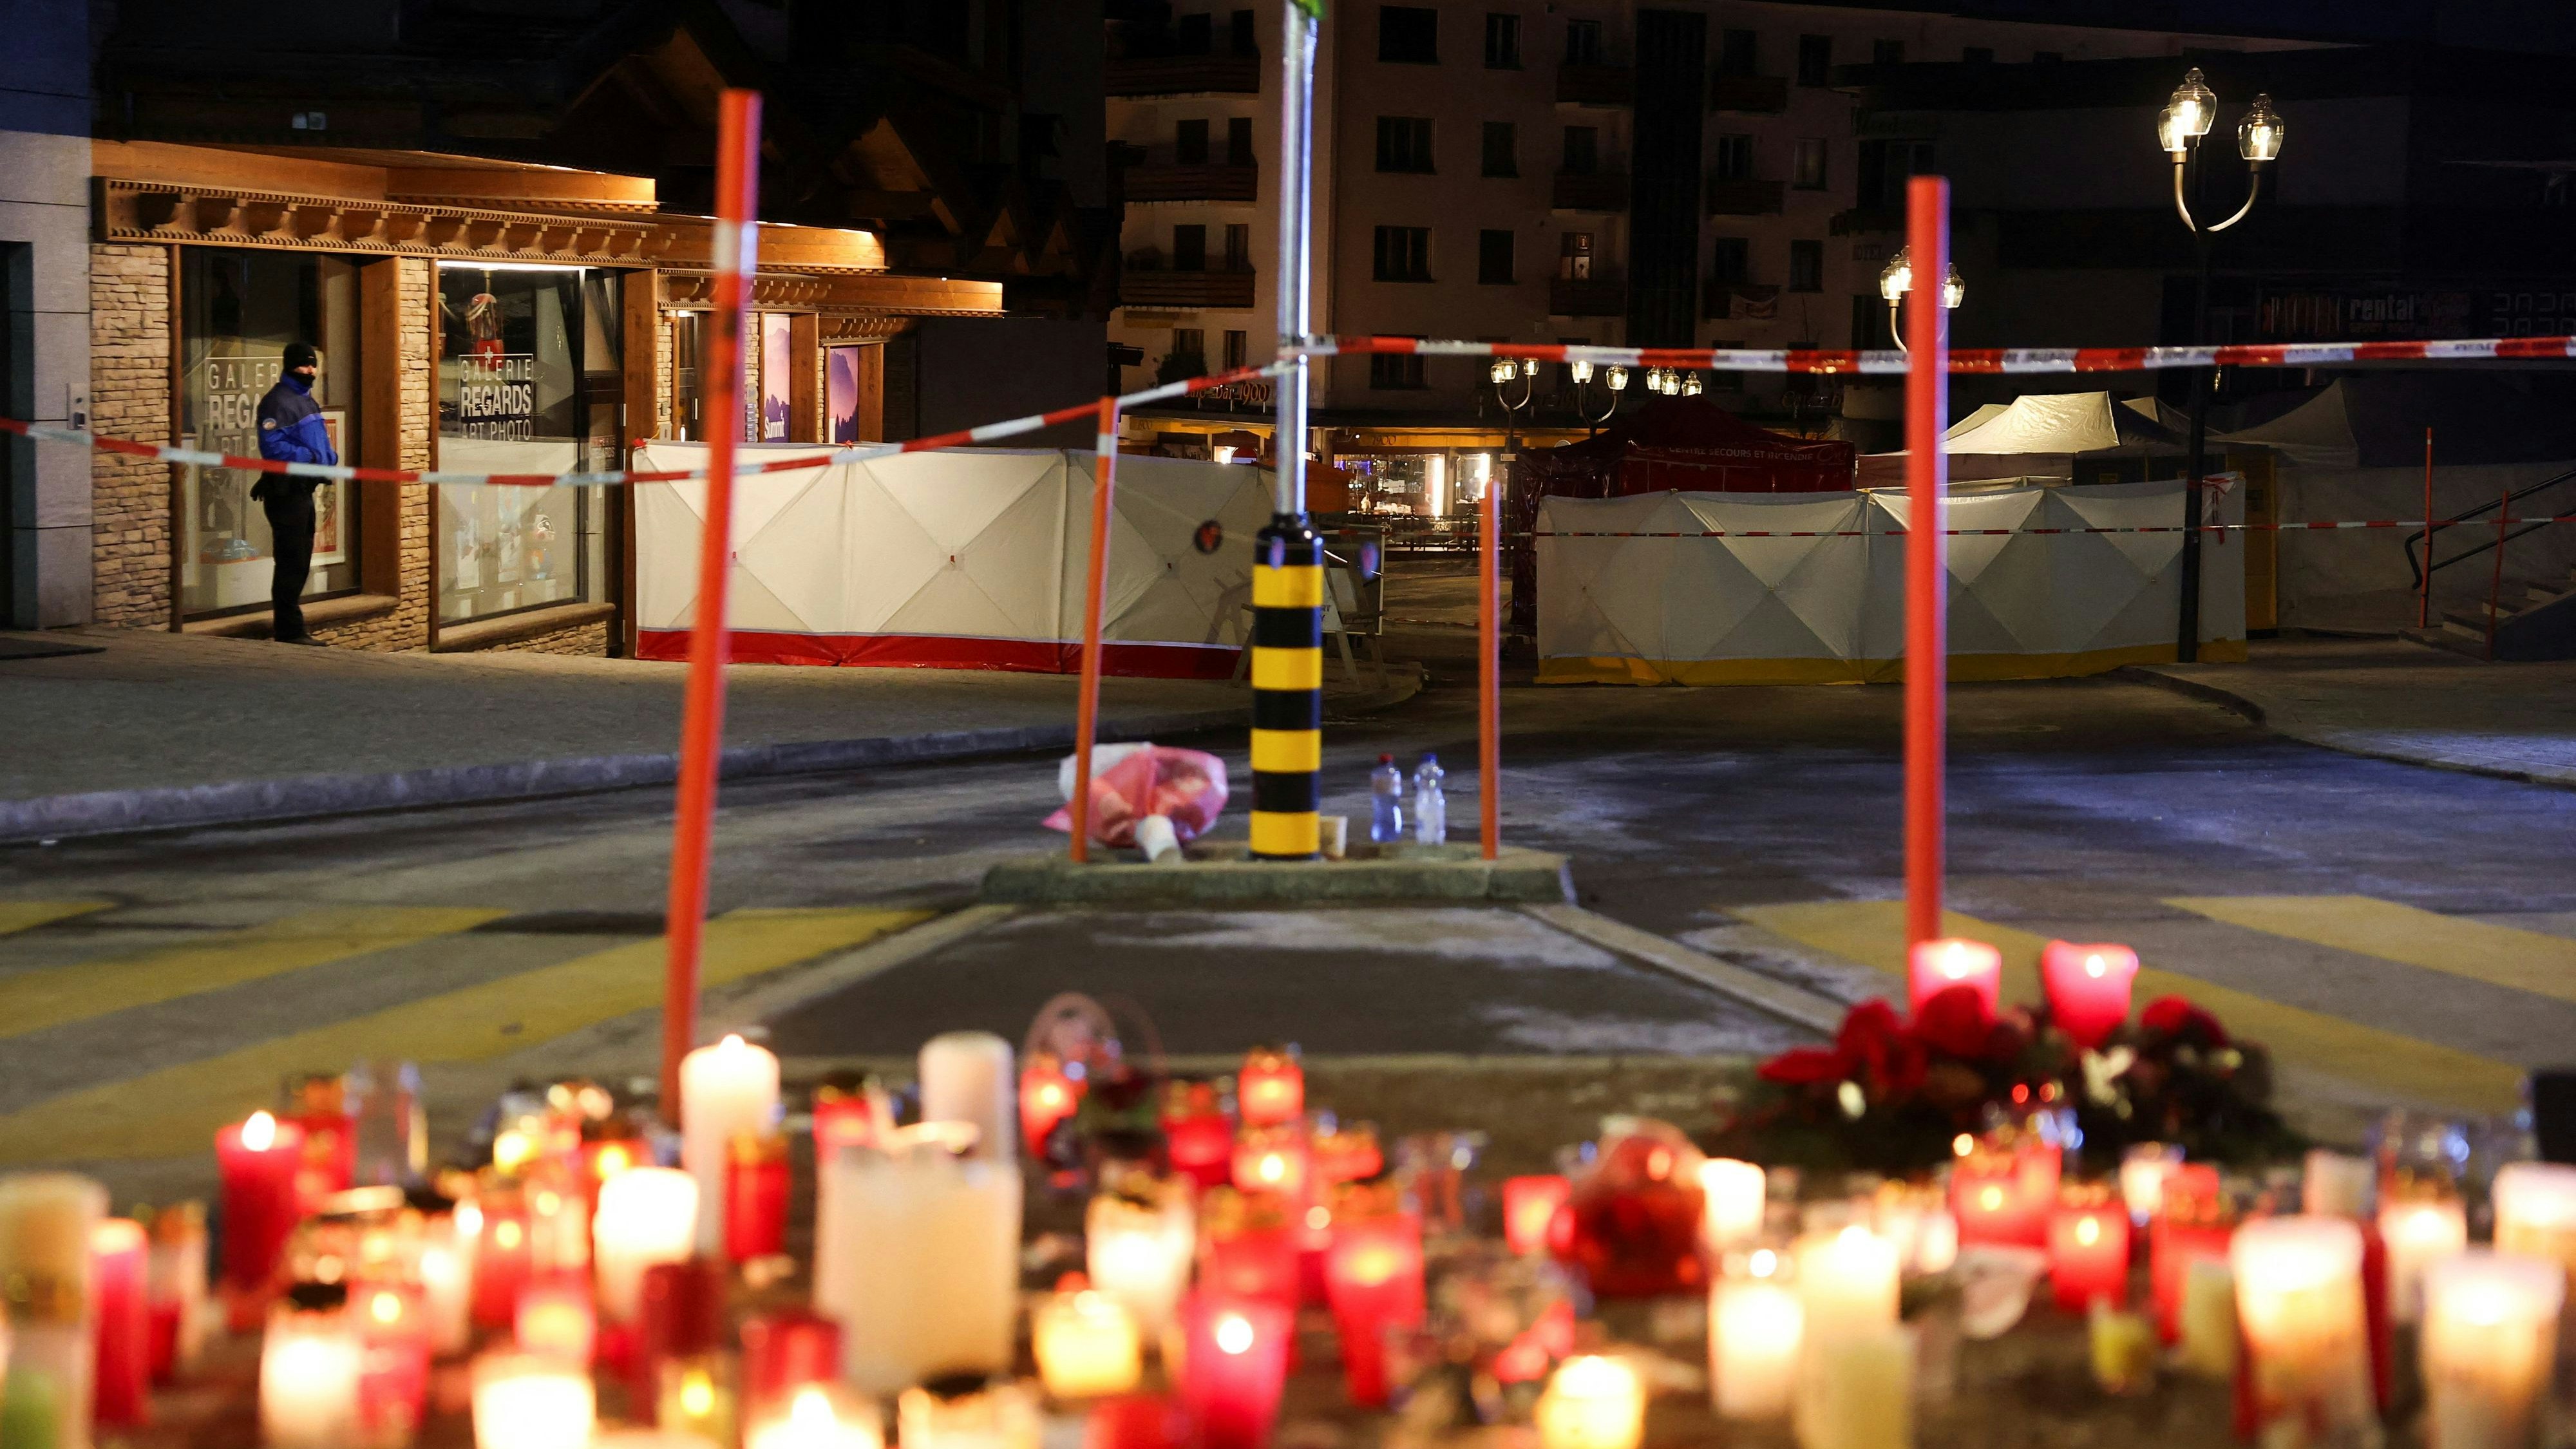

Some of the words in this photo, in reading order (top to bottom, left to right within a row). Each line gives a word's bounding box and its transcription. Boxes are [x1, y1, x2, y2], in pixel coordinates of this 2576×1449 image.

[2349, 294, 2415, 321] rental
[209, 363, 280, 389] GALER
[461, 359, 531, 382] GALERIE
[460, 384, 531, 417] REGARDS
[1239, 383, 1268, 405] 1900
[209, 393, 260, 430] REGA
[490, 419, 531, 442] PHOTO
[764, 411, 784, 439] Summit
[1372, 435, 1397, 446] 1900
[1709, 448, 1752, 459] SECOURS
[1754, 451, 1766, 459] ET
[1768, 451, 1814, 462] INCENDIE
